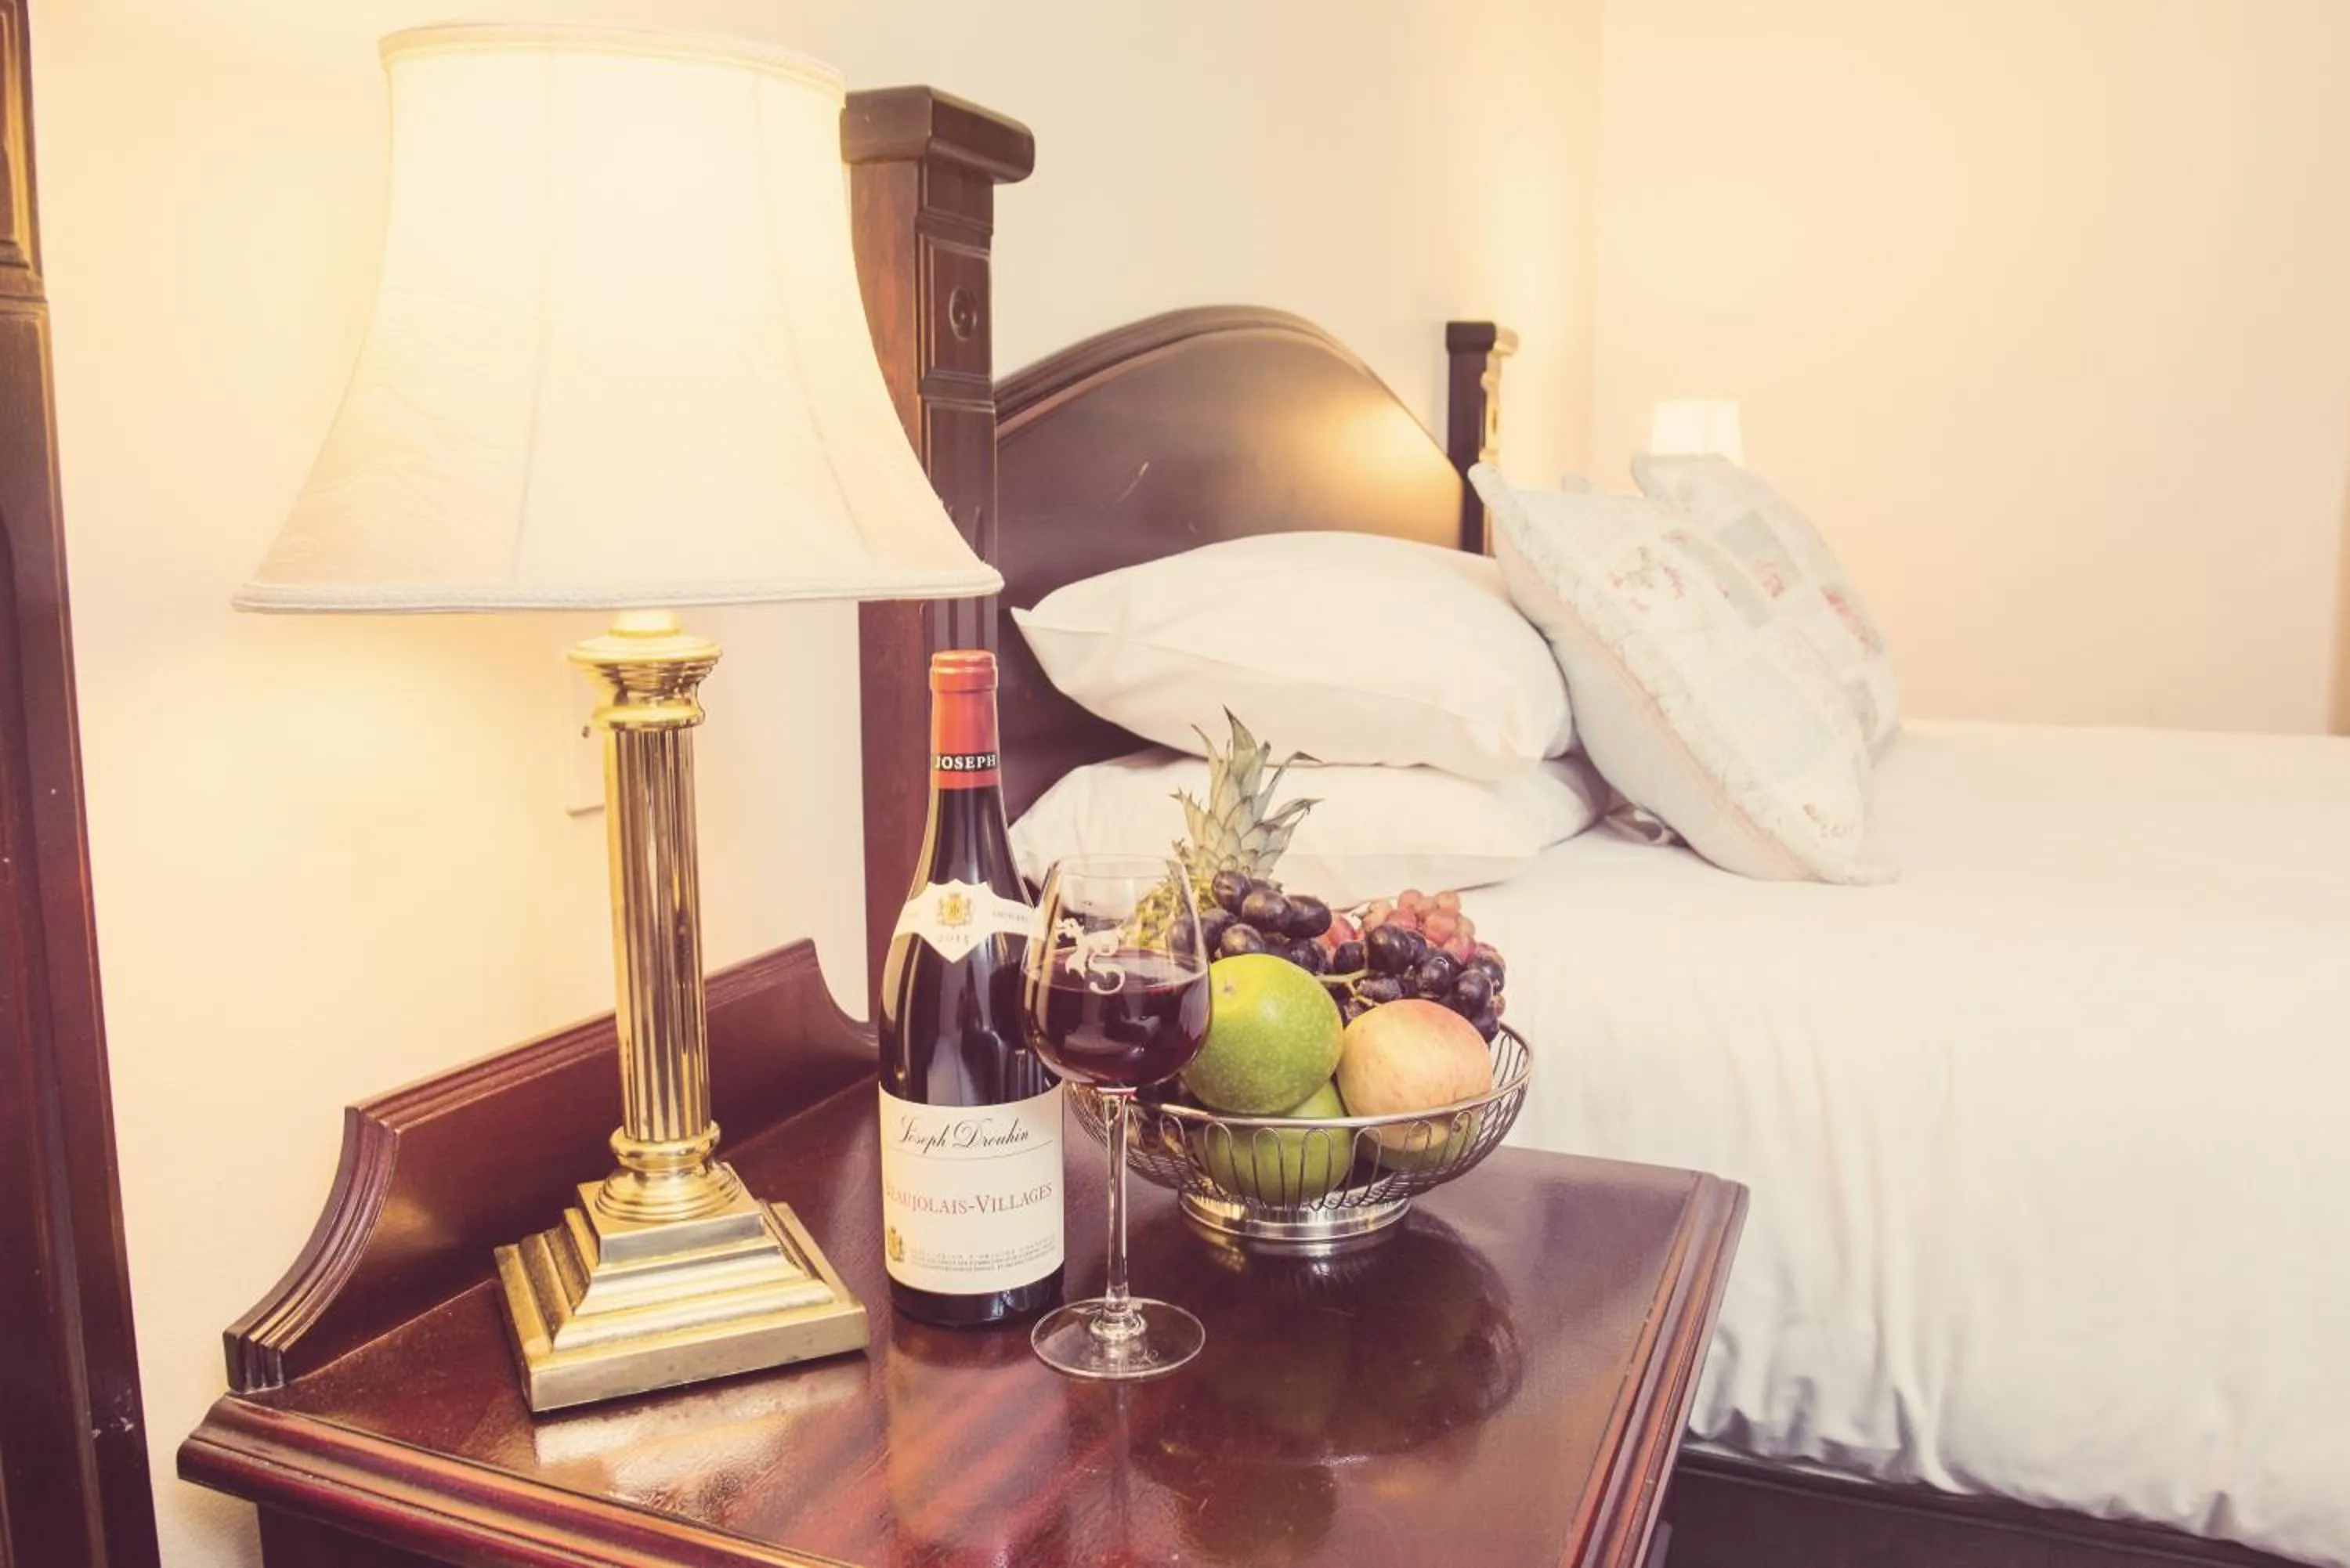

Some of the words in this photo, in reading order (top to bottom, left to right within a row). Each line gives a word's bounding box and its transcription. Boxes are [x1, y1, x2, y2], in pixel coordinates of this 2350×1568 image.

[935, 754, 996, 770] JOSEPH
[898, 1115, 951, 1154] Joseph
[953, 1117, 1029, 1148] Drouhin
